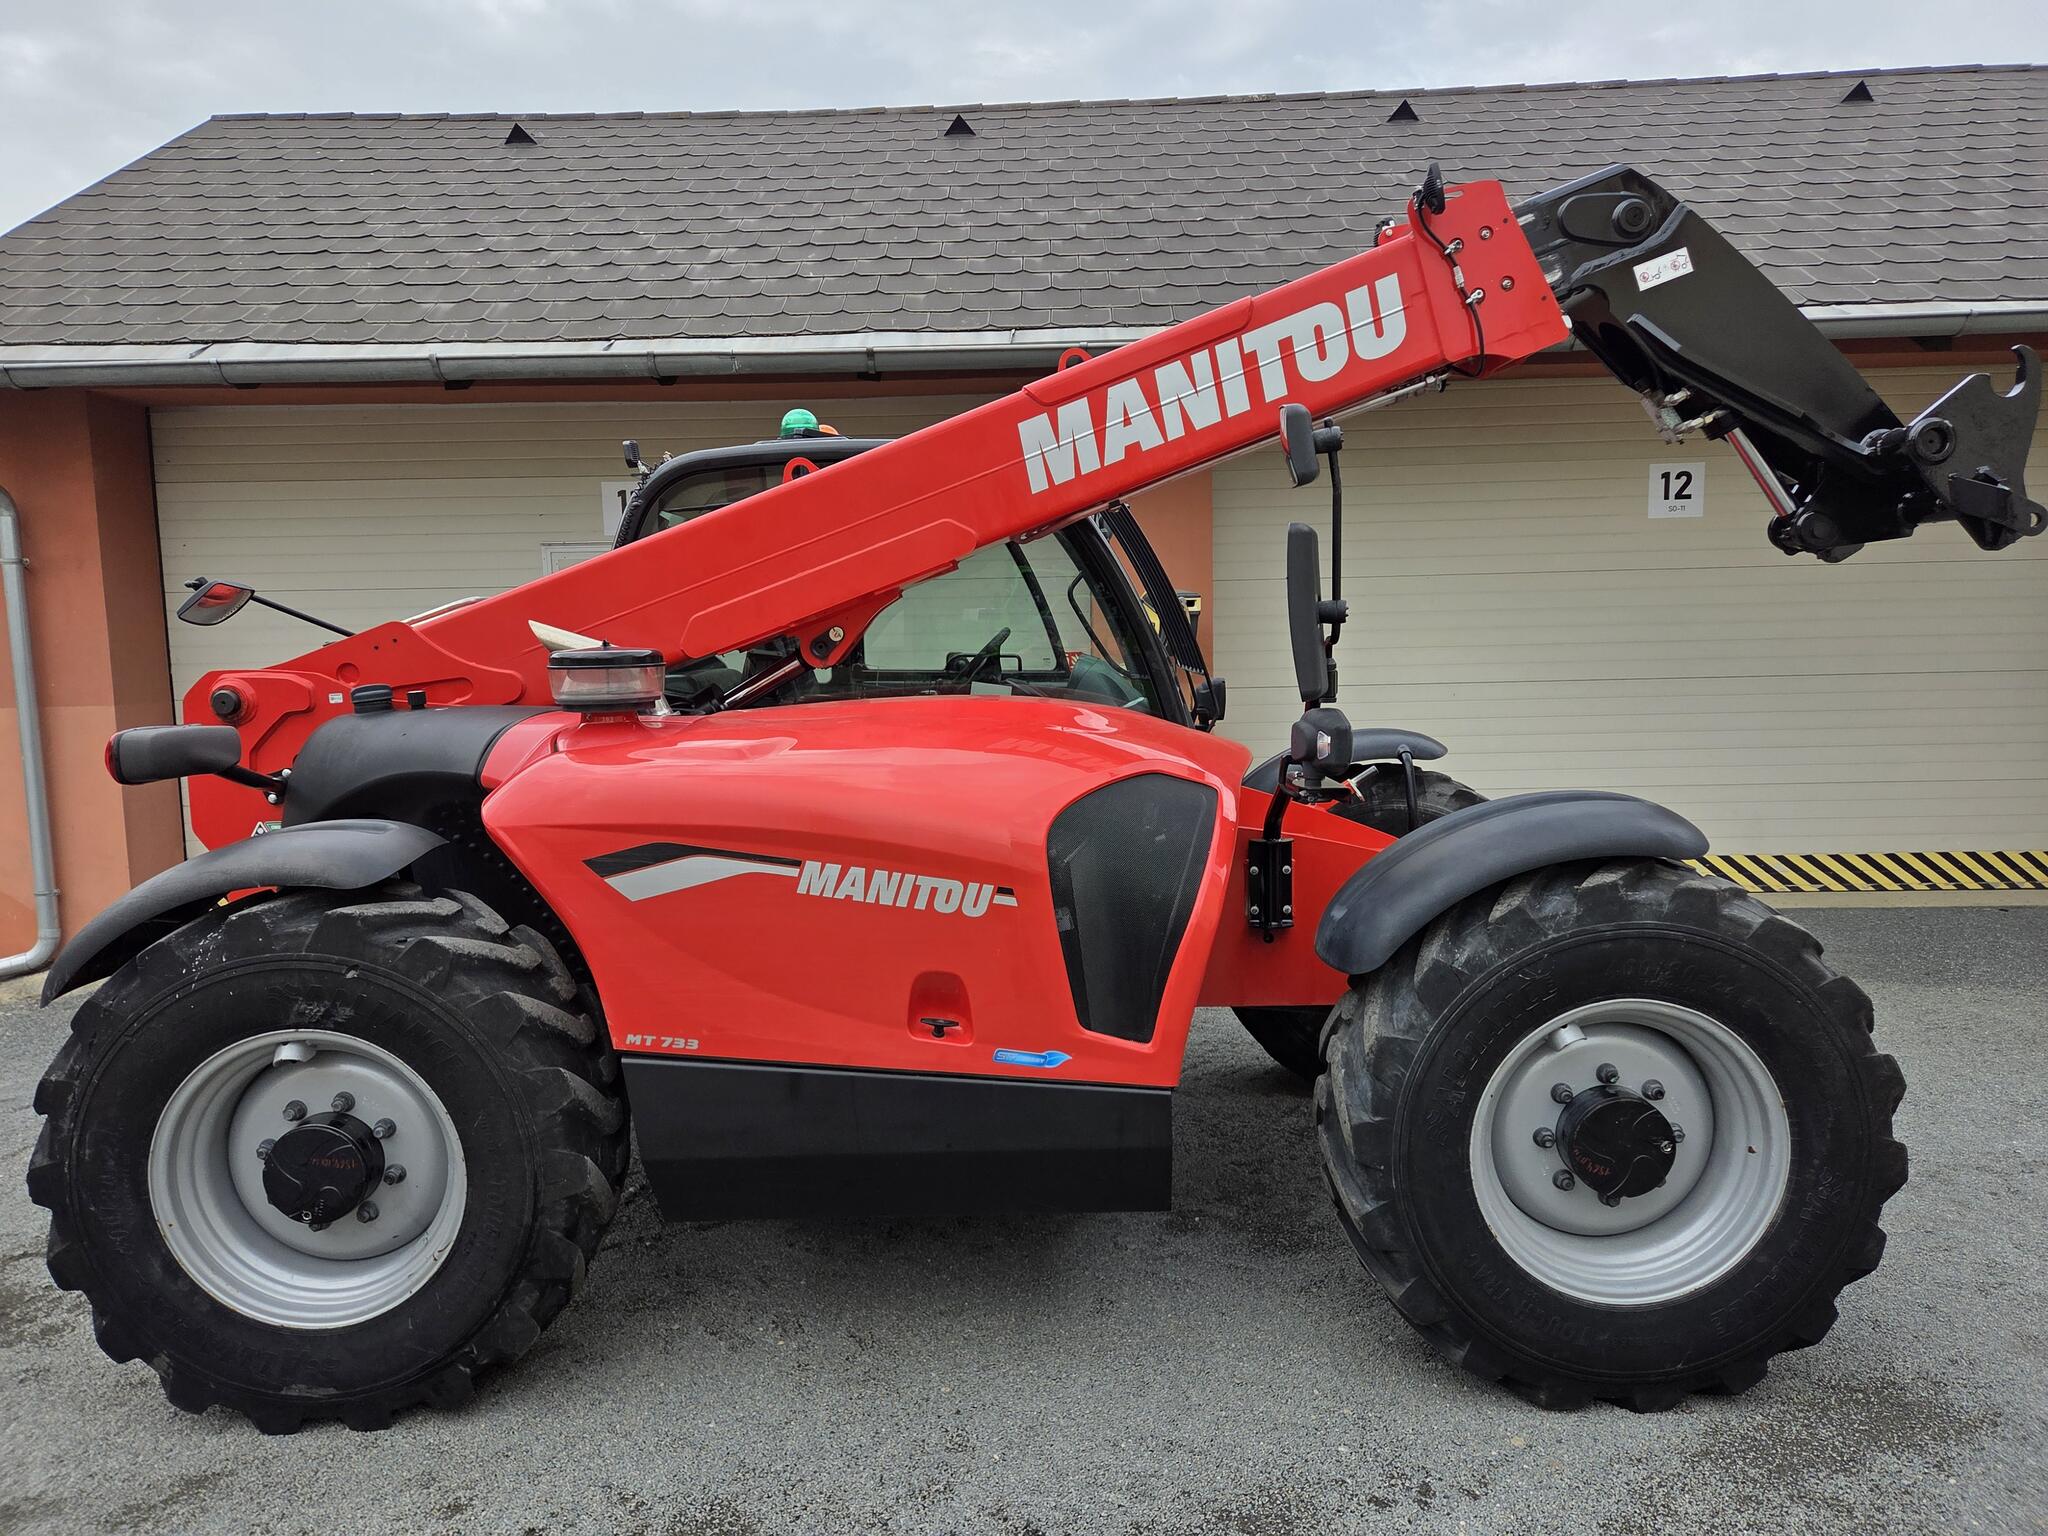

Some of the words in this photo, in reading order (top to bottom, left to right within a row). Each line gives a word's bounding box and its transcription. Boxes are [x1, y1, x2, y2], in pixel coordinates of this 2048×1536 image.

[1017, 273, 1407, 494] MANITOU
[1660, 470, 1693, 501] 12
[797, 860, 995, 918] MANITOU
[626, 1034, 656, 1046] MT
[661, 1036, 699, 1050] 733
